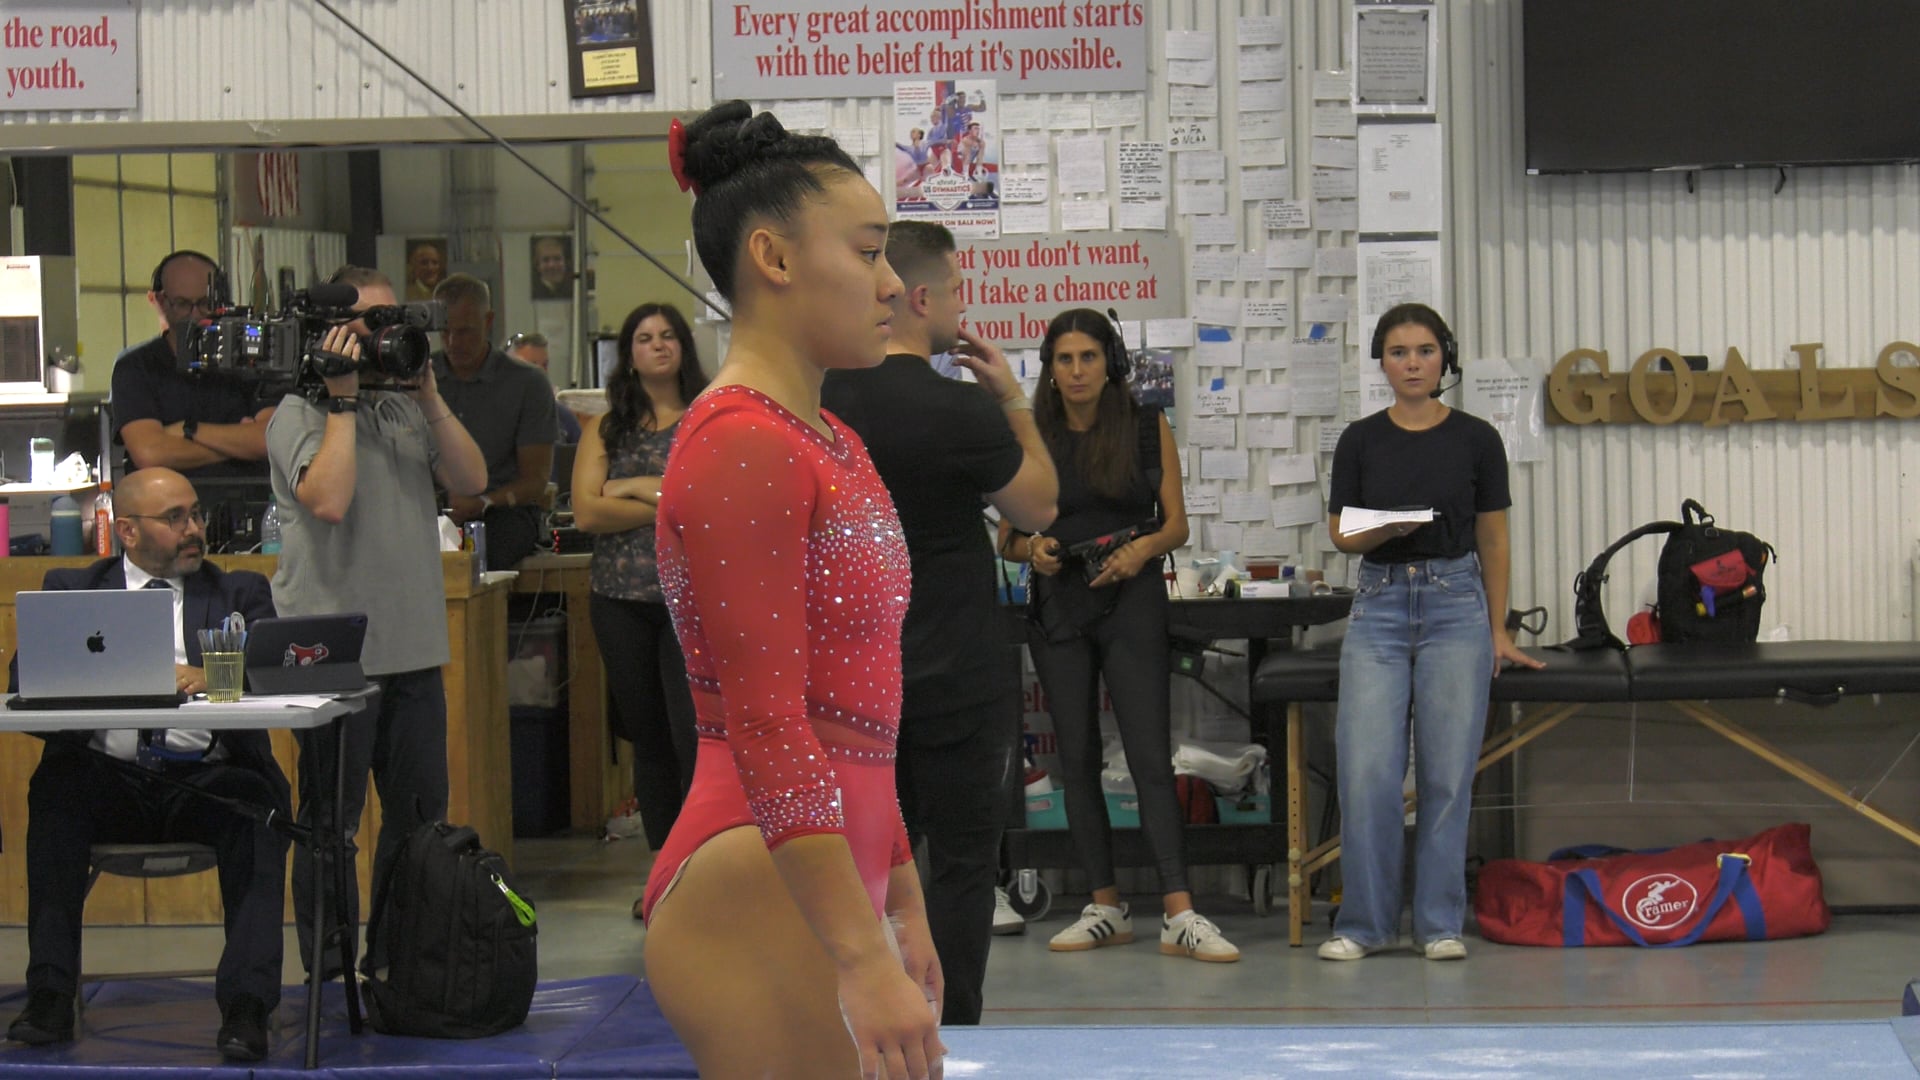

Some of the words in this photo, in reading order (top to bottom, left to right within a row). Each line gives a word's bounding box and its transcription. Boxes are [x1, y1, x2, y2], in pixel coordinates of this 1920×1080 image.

[4, 16, 44, 48] the
[51, 16, 117, 55] road,
[733, 4, 800, 43] Every
[807, 4, 869, 43] great
[876, 0, 1067, 40] accomplishment
[1073, 0, 1143, 28] starts
[7, 57, 85, 98] youth.
[756, 44, 808, 78] with
[813, 44, 850, 76] the
[856, 41, 924, 75] belief
[928, 41, 973, 73] that
[981, 40, 1013, 72] it's
[1019, 37, 1122, 80] possible.
[982, 248, 1021, 276] you
[1026, 239, 1081, 267] don't
[1087, 239, 1149, 270] want,
[980, 277, 1029, 304] take
[1034, 284, 1047, 303] a
[1053, 275, 1131, 303] chance
[1136, 274, 1158, 299] at
[975, 320, 1013, 340] you
[1019, 312, 1050, 340] lov
[1550, 341, 1920, 428] GOALS
